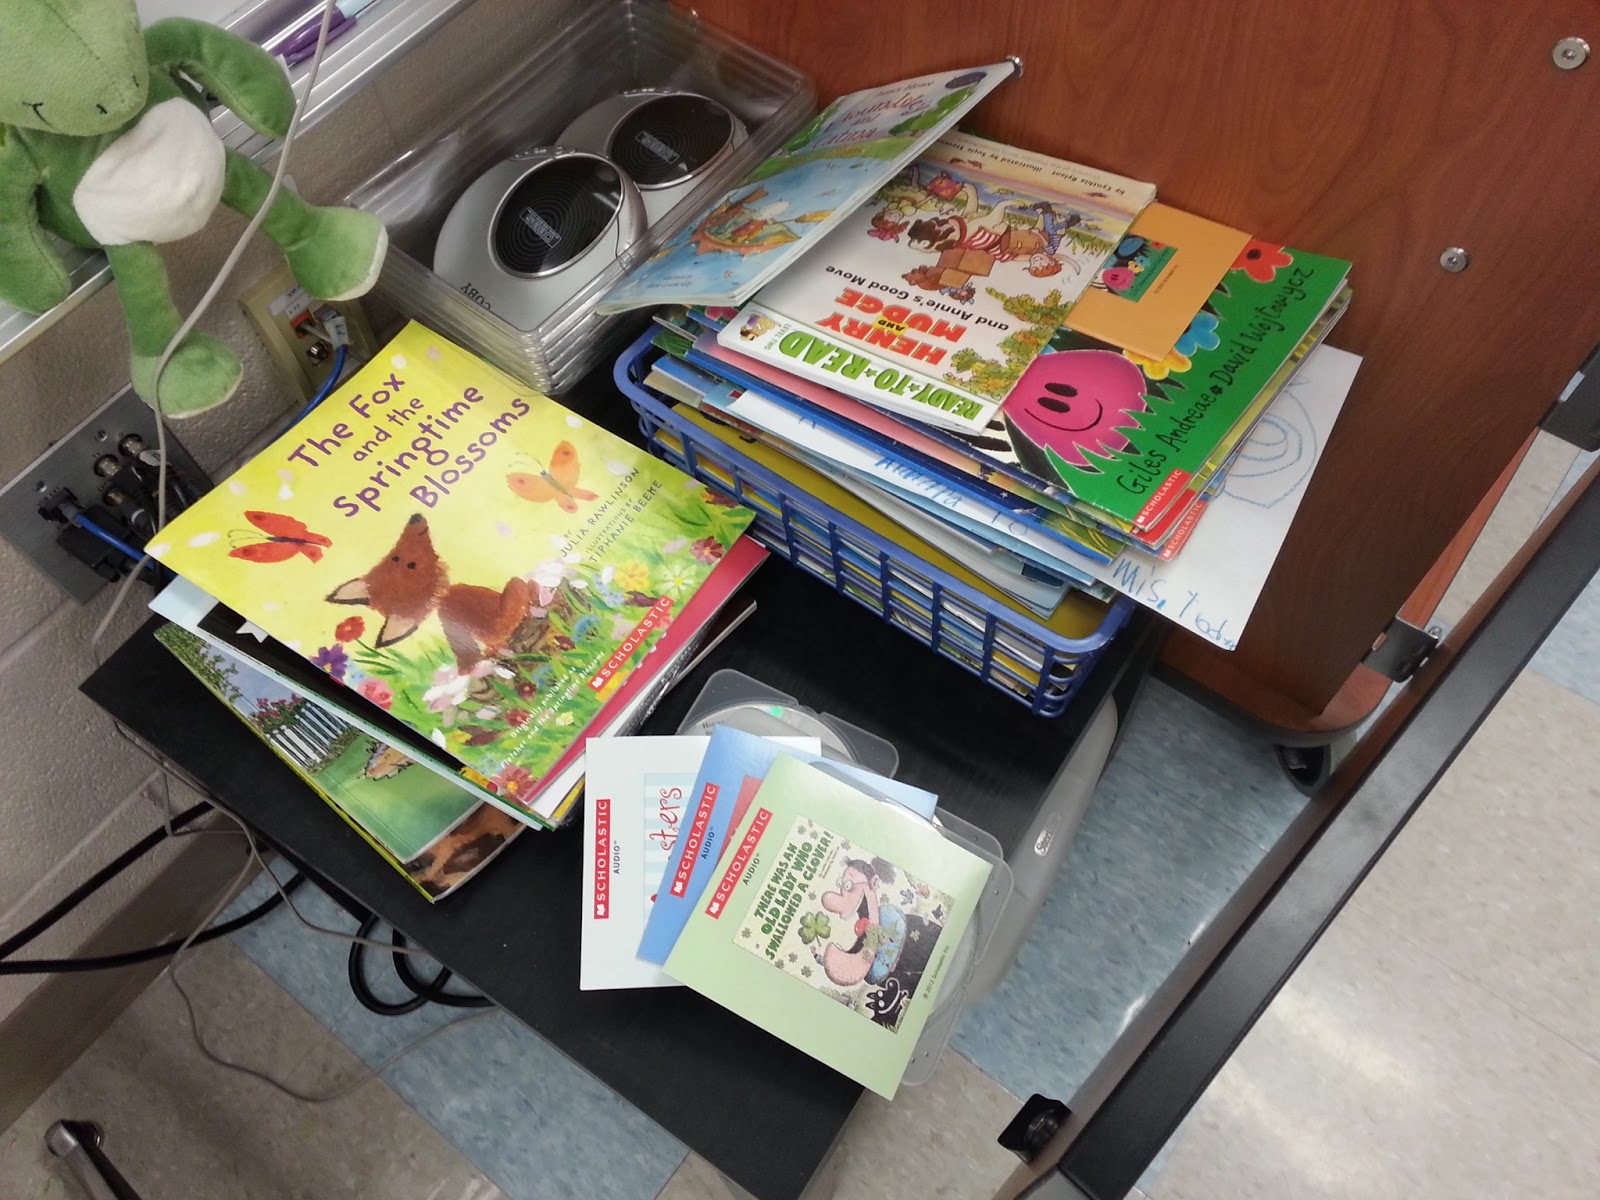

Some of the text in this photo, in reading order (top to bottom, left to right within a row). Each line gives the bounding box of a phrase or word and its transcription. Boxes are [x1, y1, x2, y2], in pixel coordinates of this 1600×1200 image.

[1052, 170, 1078, 182] Rylant
[1080, 178, 1111, 191] Cynthia
[825, 264, 1009, 331] and Annie's Good Move
[834, 287, 967, 343] MUDGE
[877, 319, 906, 332] AND
[815, 311, 948, 366] HENRY
[287, 373, 405, 467] The Fox
[333, 387, 484, 518] Springtime
[353, 398, 425, 462] and the
[409, 398, 530, 508] Blossoms
[1116, 448, 1168, 495] Giles
[1155, 393, 1217, 453] Andreae
[1209, 339, 1256, 388] David
[560, 467, 639, 558] JULIA RAWLINSON
[585, 497, 633, 554] ILLUSTRATIONS BY
[589, 480, 662, 563] TIPHANIE BEEKE
[1142, 469, 1182, 516] SCHOLASTIC
[1168, 502, 1203, 551] SCHOLASTIC
[600, 597, 672, 679] SCHOLASTIC
[510, 705, 542, 738] Originally
[542, 673, 569, 706] published
[528, 725, 540, 740] and
[538, 712, 550, 726] the
[548, 679, 580, 713] Springtime
[578, 651, 605, 679] Blossoms
[596, 801, 608, 901] SCHOLASTIC
[648, 787, 682, 852] sters
[678, 785, 717, 881] SCHOLASTIC
[716, 811, 769, 902] SCHOLASTIC
[753, 842, 798, 919] THERE WAS AN
[761, 842, 813, 935] OLD LADY WHO
[765, 893, 802, 961] SWALLOWED
[797, 882, 809, 894] A
[803, 830, 834, 881] CLOVER!
